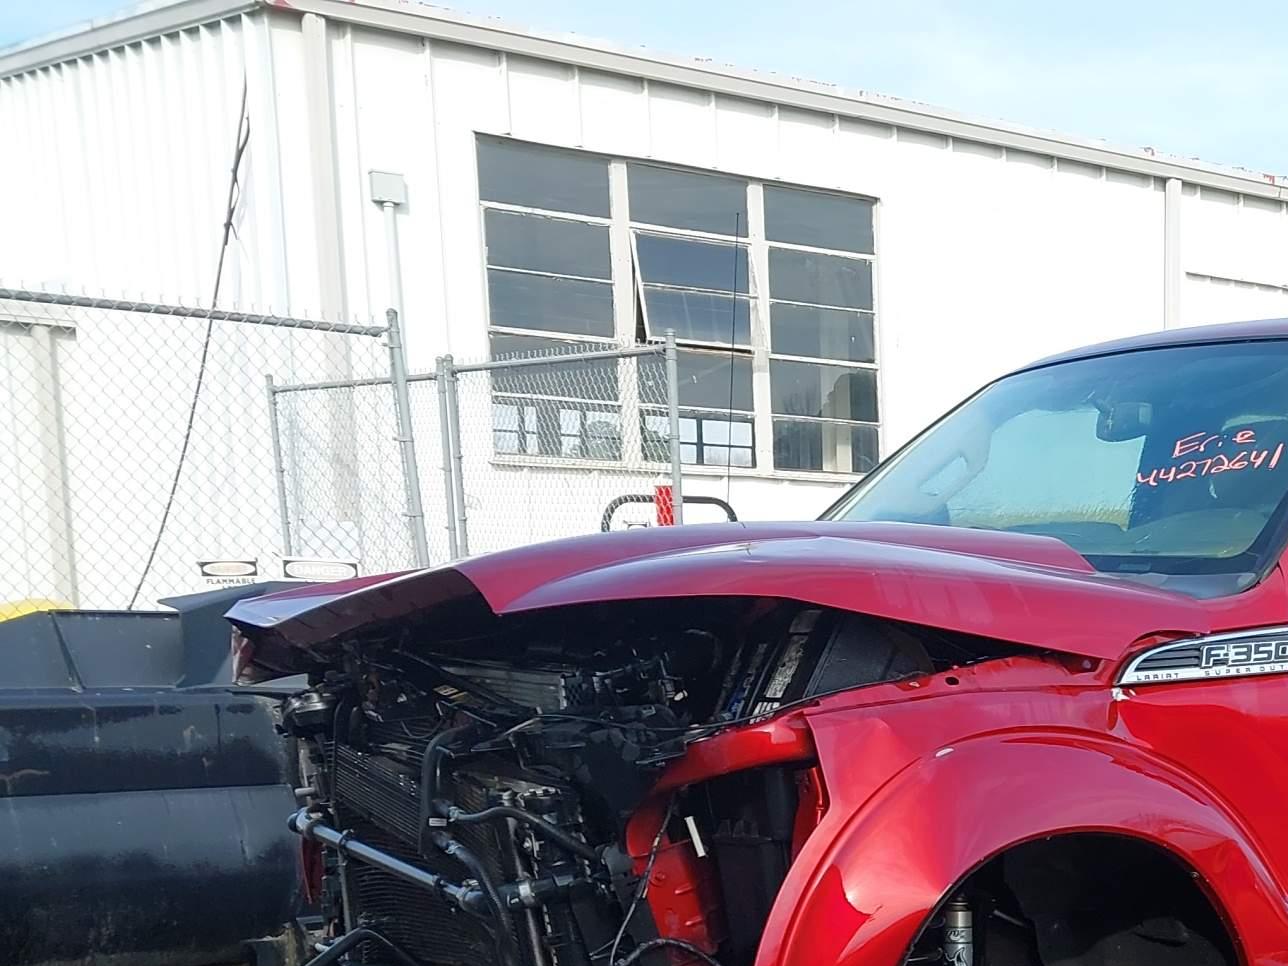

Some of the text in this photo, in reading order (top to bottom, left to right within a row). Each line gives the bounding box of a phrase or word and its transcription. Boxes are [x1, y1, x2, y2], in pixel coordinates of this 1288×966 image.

[1136, 443, 1285, 486] 44272641
[206, 577, 256, 585] FLAMMABLE
[1136, 672, 1180, 681] LARIAT
[1204, 667, 1251, 676] SUPER
